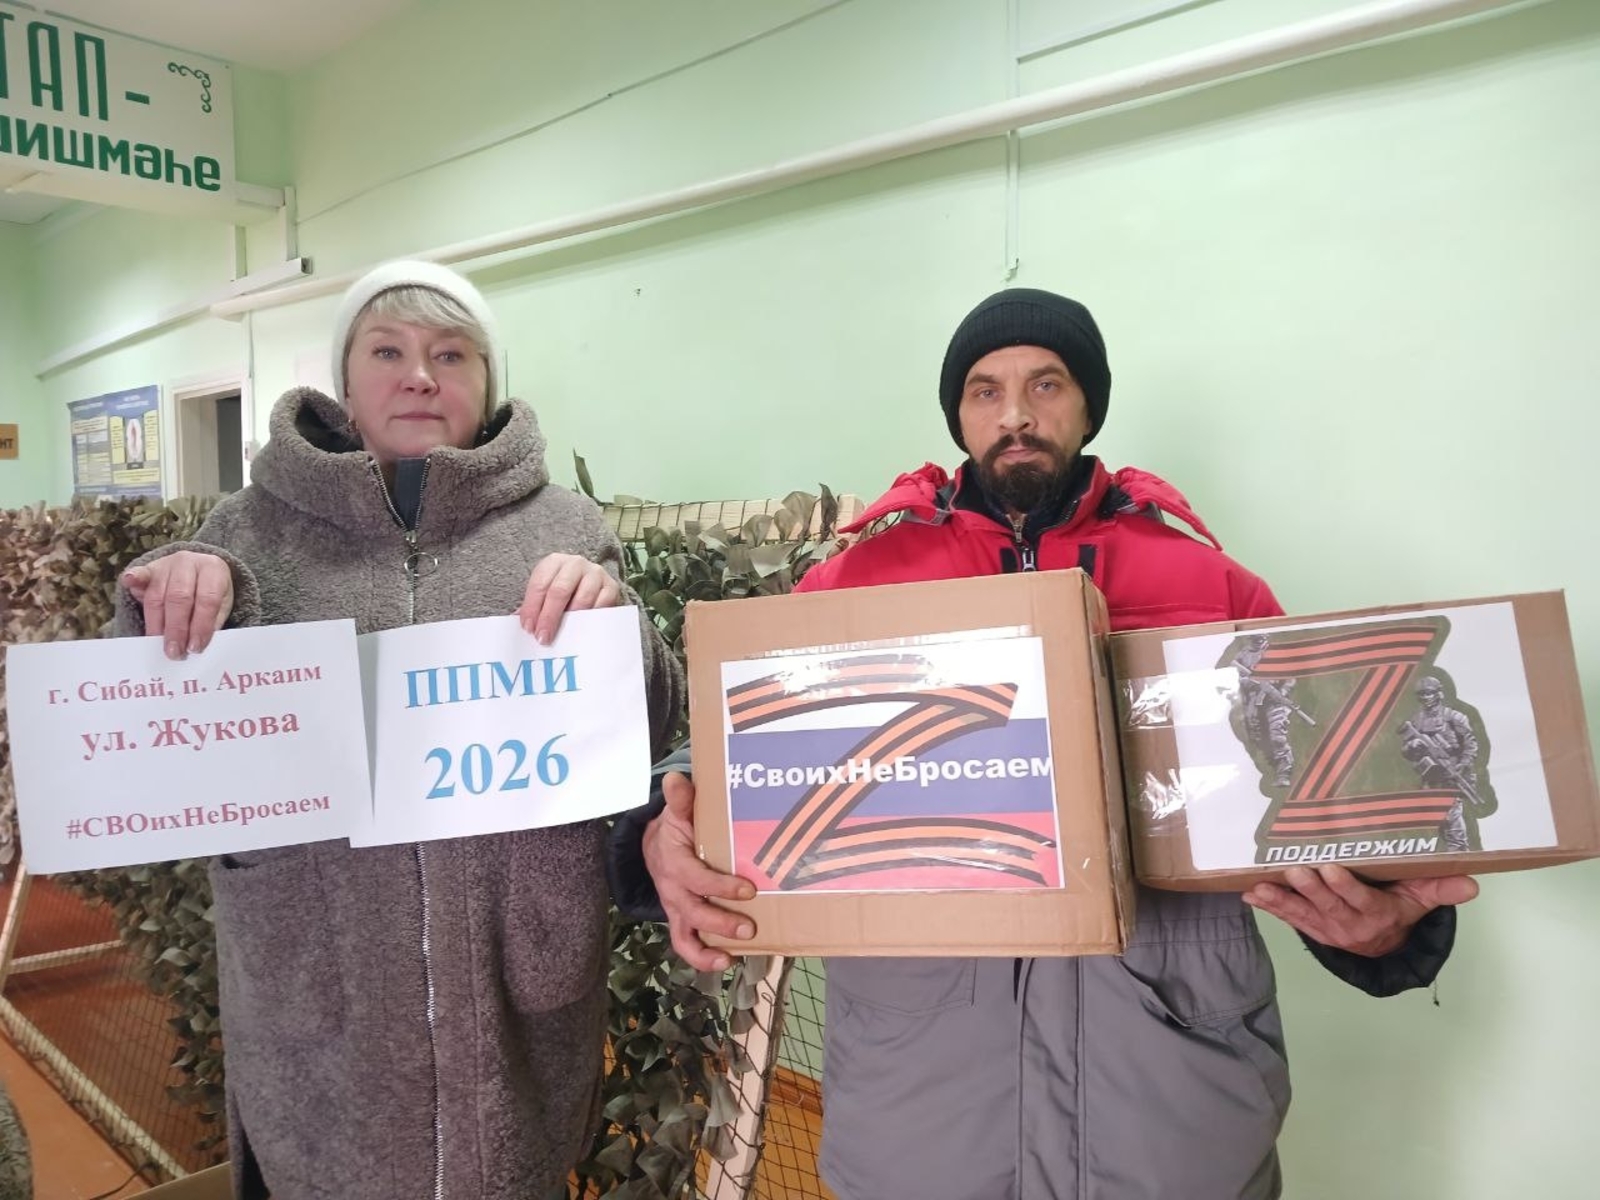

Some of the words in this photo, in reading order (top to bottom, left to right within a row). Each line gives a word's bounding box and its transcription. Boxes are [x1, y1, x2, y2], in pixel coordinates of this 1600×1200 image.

[48, 689, 69, 704] г.
[78, 677, 174, 703] Сибай,
[182, 679, 207, 695] п.
[216, 664, 322, 695] Аркаим
[403, 655, 582, 709] ППМИ
[81, 730, 137, 761] ул.
[148, 711, 300, 751] Жукова
[424, 733, 570, 800] 2026
[728, 756, 1052, 790] #СвоихНеБросаем
[66, 795, 331, 839] #СВОихНеБросаем
[1265, 837, 1439, 863] ПОДДЕРЖИМ
